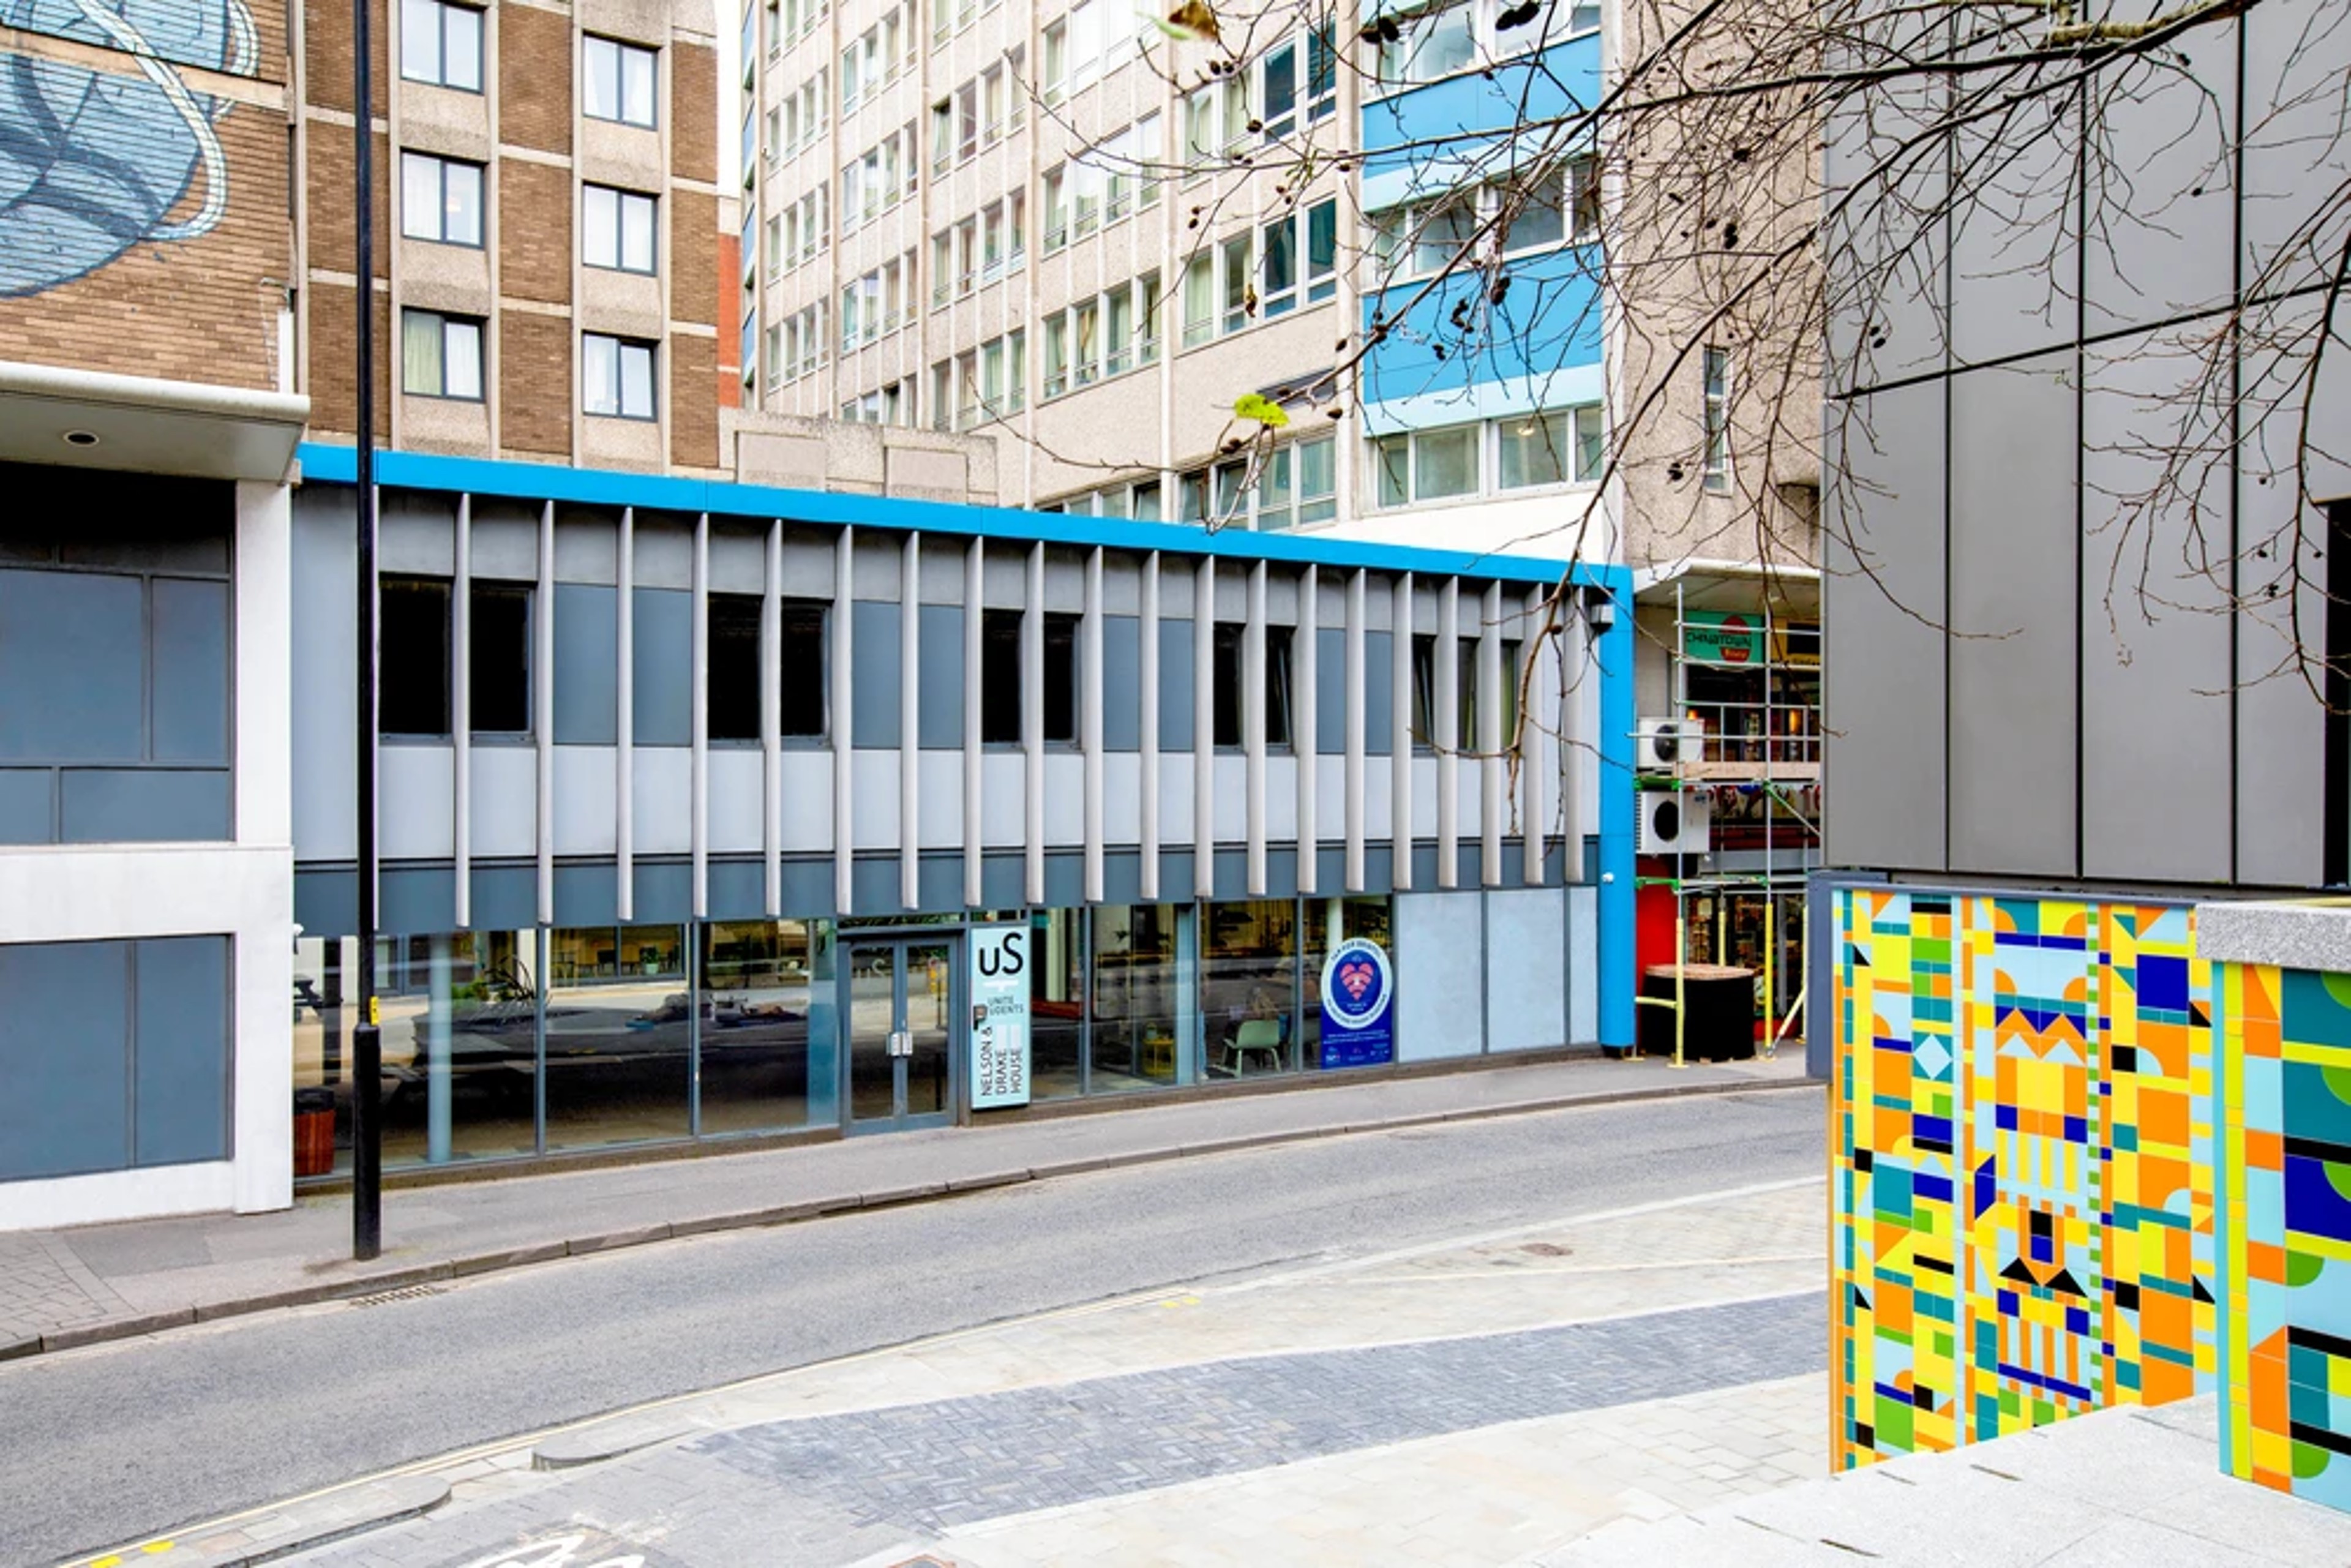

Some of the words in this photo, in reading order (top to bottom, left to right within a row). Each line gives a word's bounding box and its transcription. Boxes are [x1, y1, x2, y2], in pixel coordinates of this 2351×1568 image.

[980, 932, 1024, 976] uS
[987, 996, 1014, 1005] UNITE
[989, 1003, 1024, 1016] UDENTS
[980, 1026, 992, 1037] &
[980, 1041, 992, 1096] NELSON
[995, 1048, 1007, 1095] DRAKE
[1010, 1048, 1022, 1094] HOUSE
